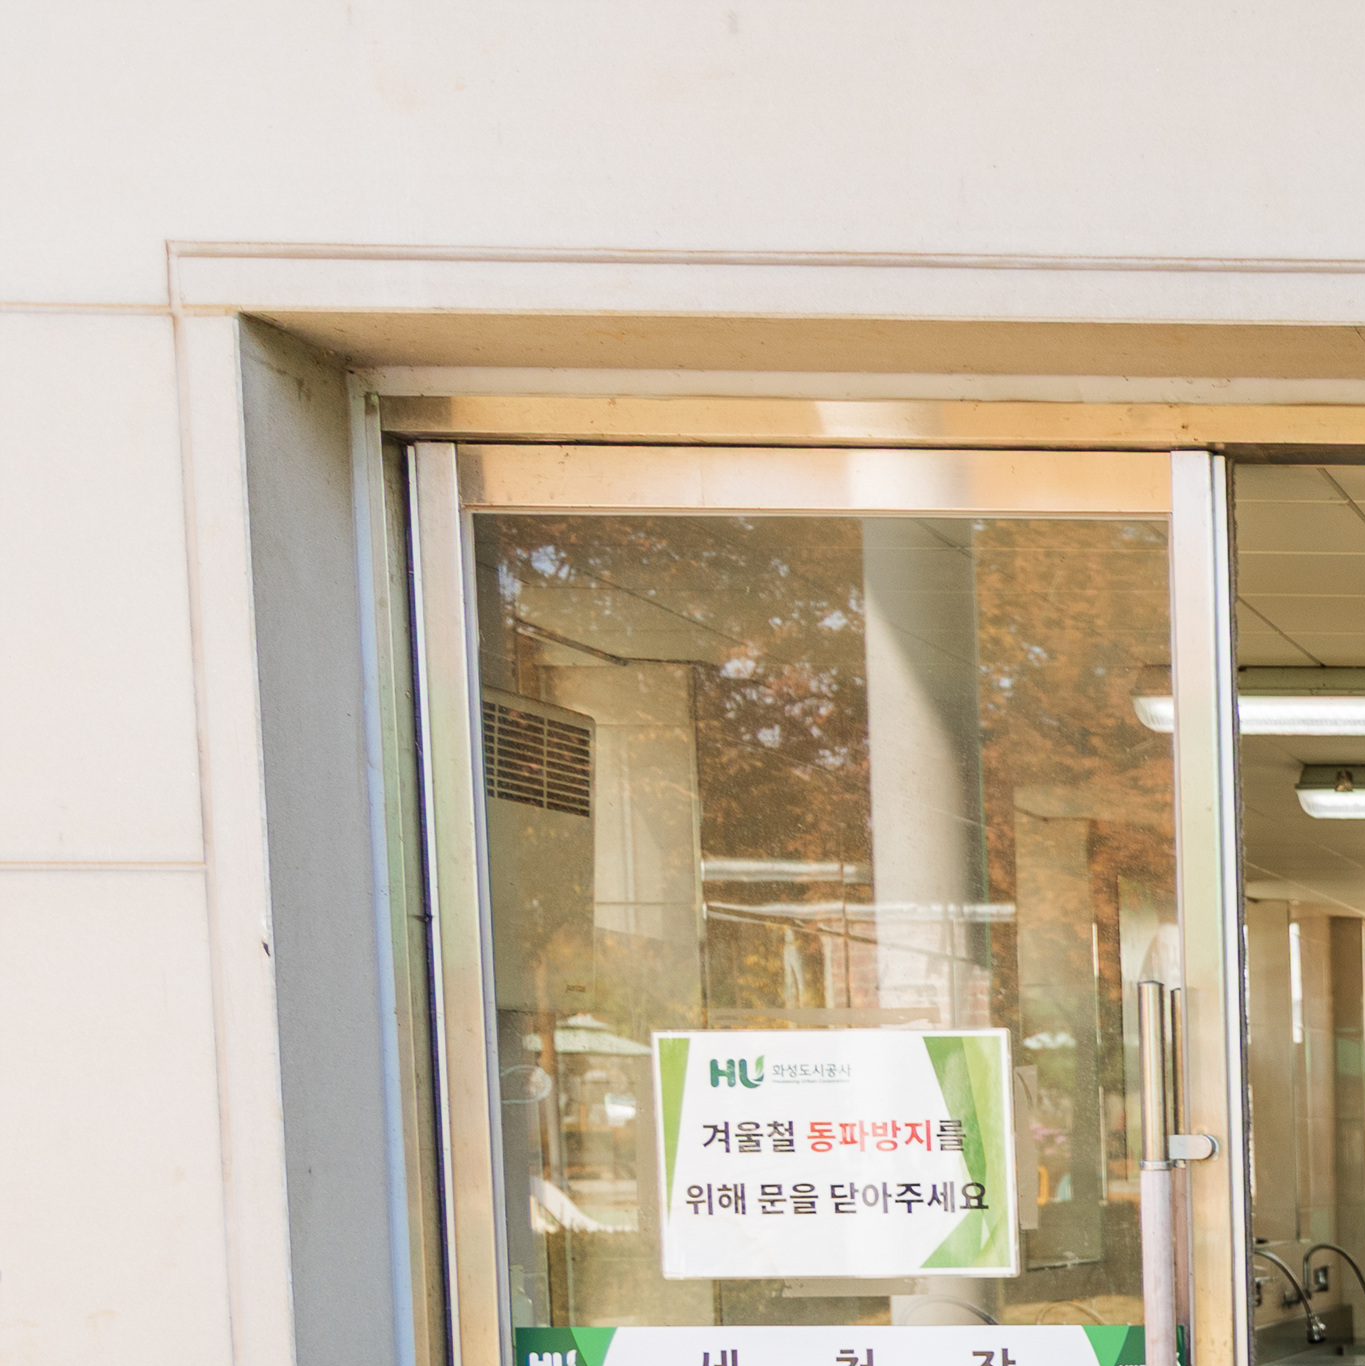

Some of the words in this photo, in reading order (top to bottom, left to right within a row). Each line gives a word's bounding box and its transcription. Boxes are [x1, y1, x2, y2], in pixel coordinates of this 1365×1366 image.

[709, 1054, 765, 1089] HU
[772, 1063, 851, 1078] 화성도시공사
[702, 1120, 796, 1153] 겨울철
[806, 1119, 967, 1153] 동파방지를
[685, 1182, 747, 1215] 위해
[757, 1183, 819, 1216] 문을
[829, 1181, 989, 1215] 닫아주세요
